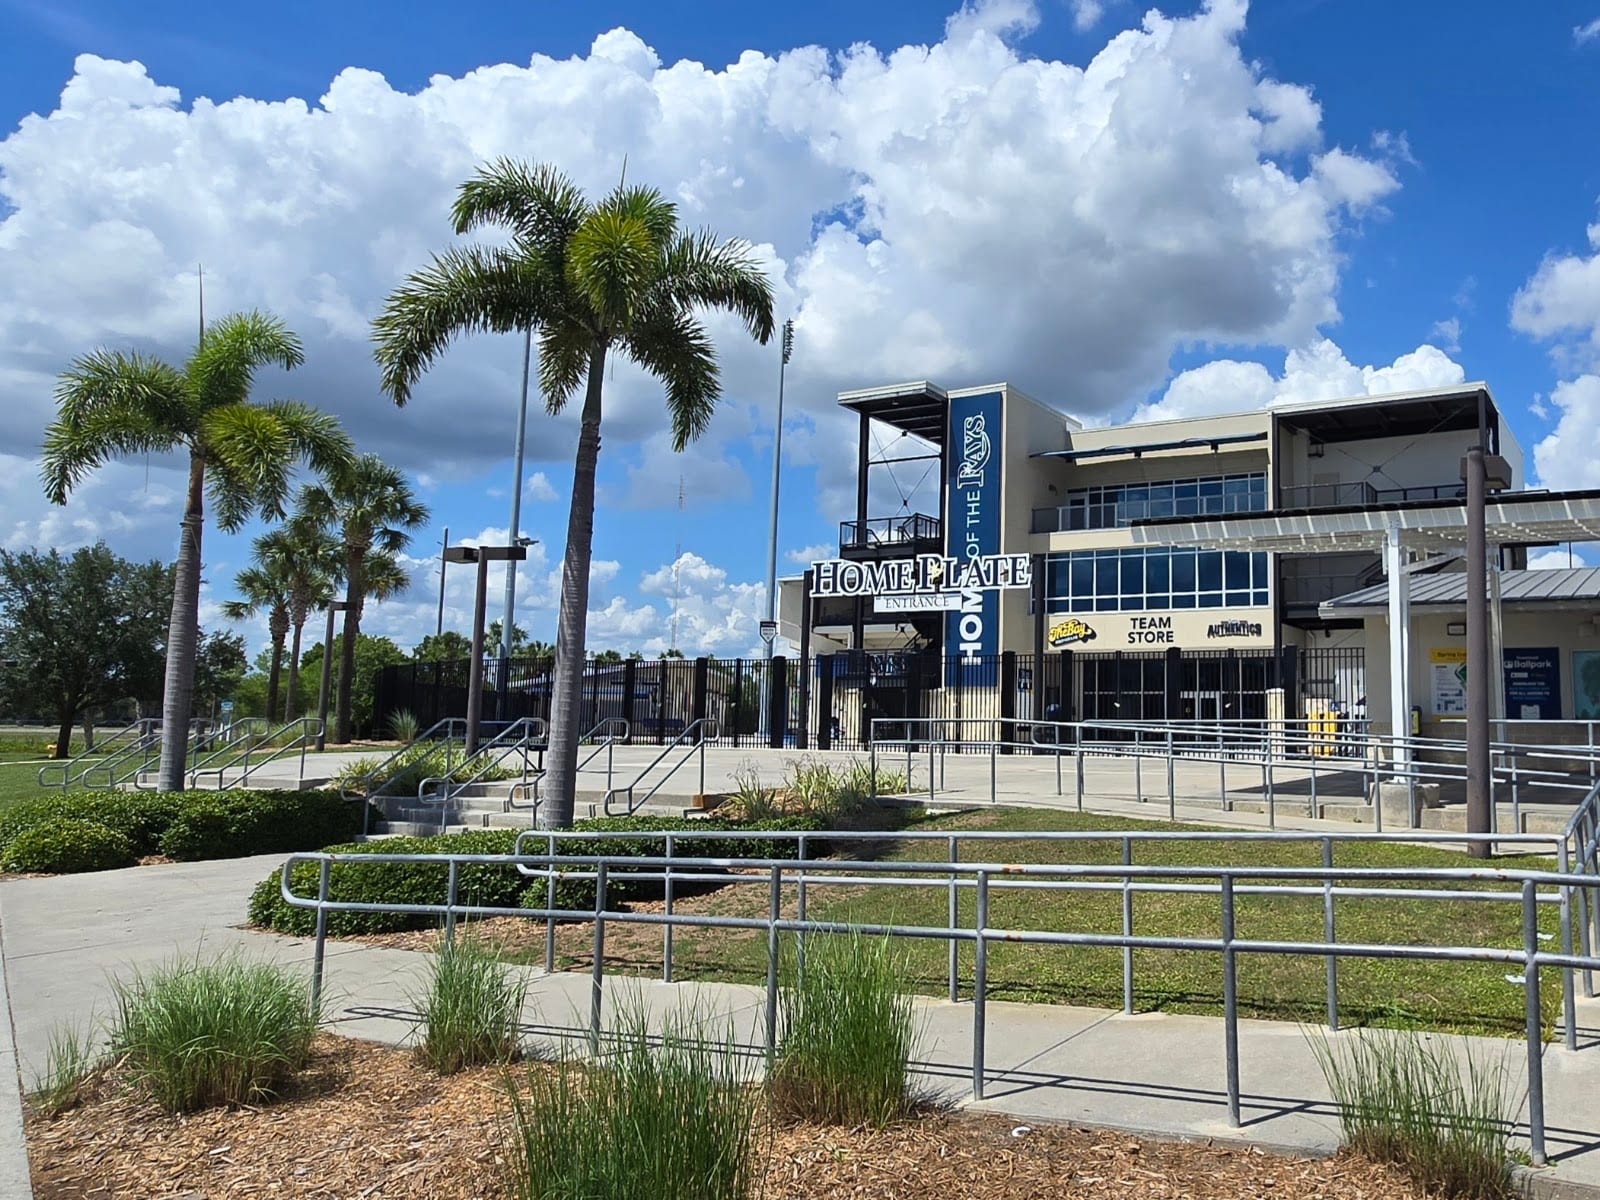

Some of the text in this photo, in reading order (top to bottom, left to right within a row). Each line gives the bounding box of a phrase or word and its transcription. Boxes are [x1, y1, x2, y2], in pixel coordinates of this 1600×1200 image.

[957, 414, 991, 489] RAYS
[967, 490, 980, 528] THE
[966, 532, 979, 558] OF
[811, 553, 1031, 596] HOME PLATE
[885, 596, 950, 609] ENTRANCE
[1130, 616, 1171, 630] TEAM
[1127, 631, 1174, 644] STORE
[1514, 659, 1552, 669] Ballpark
